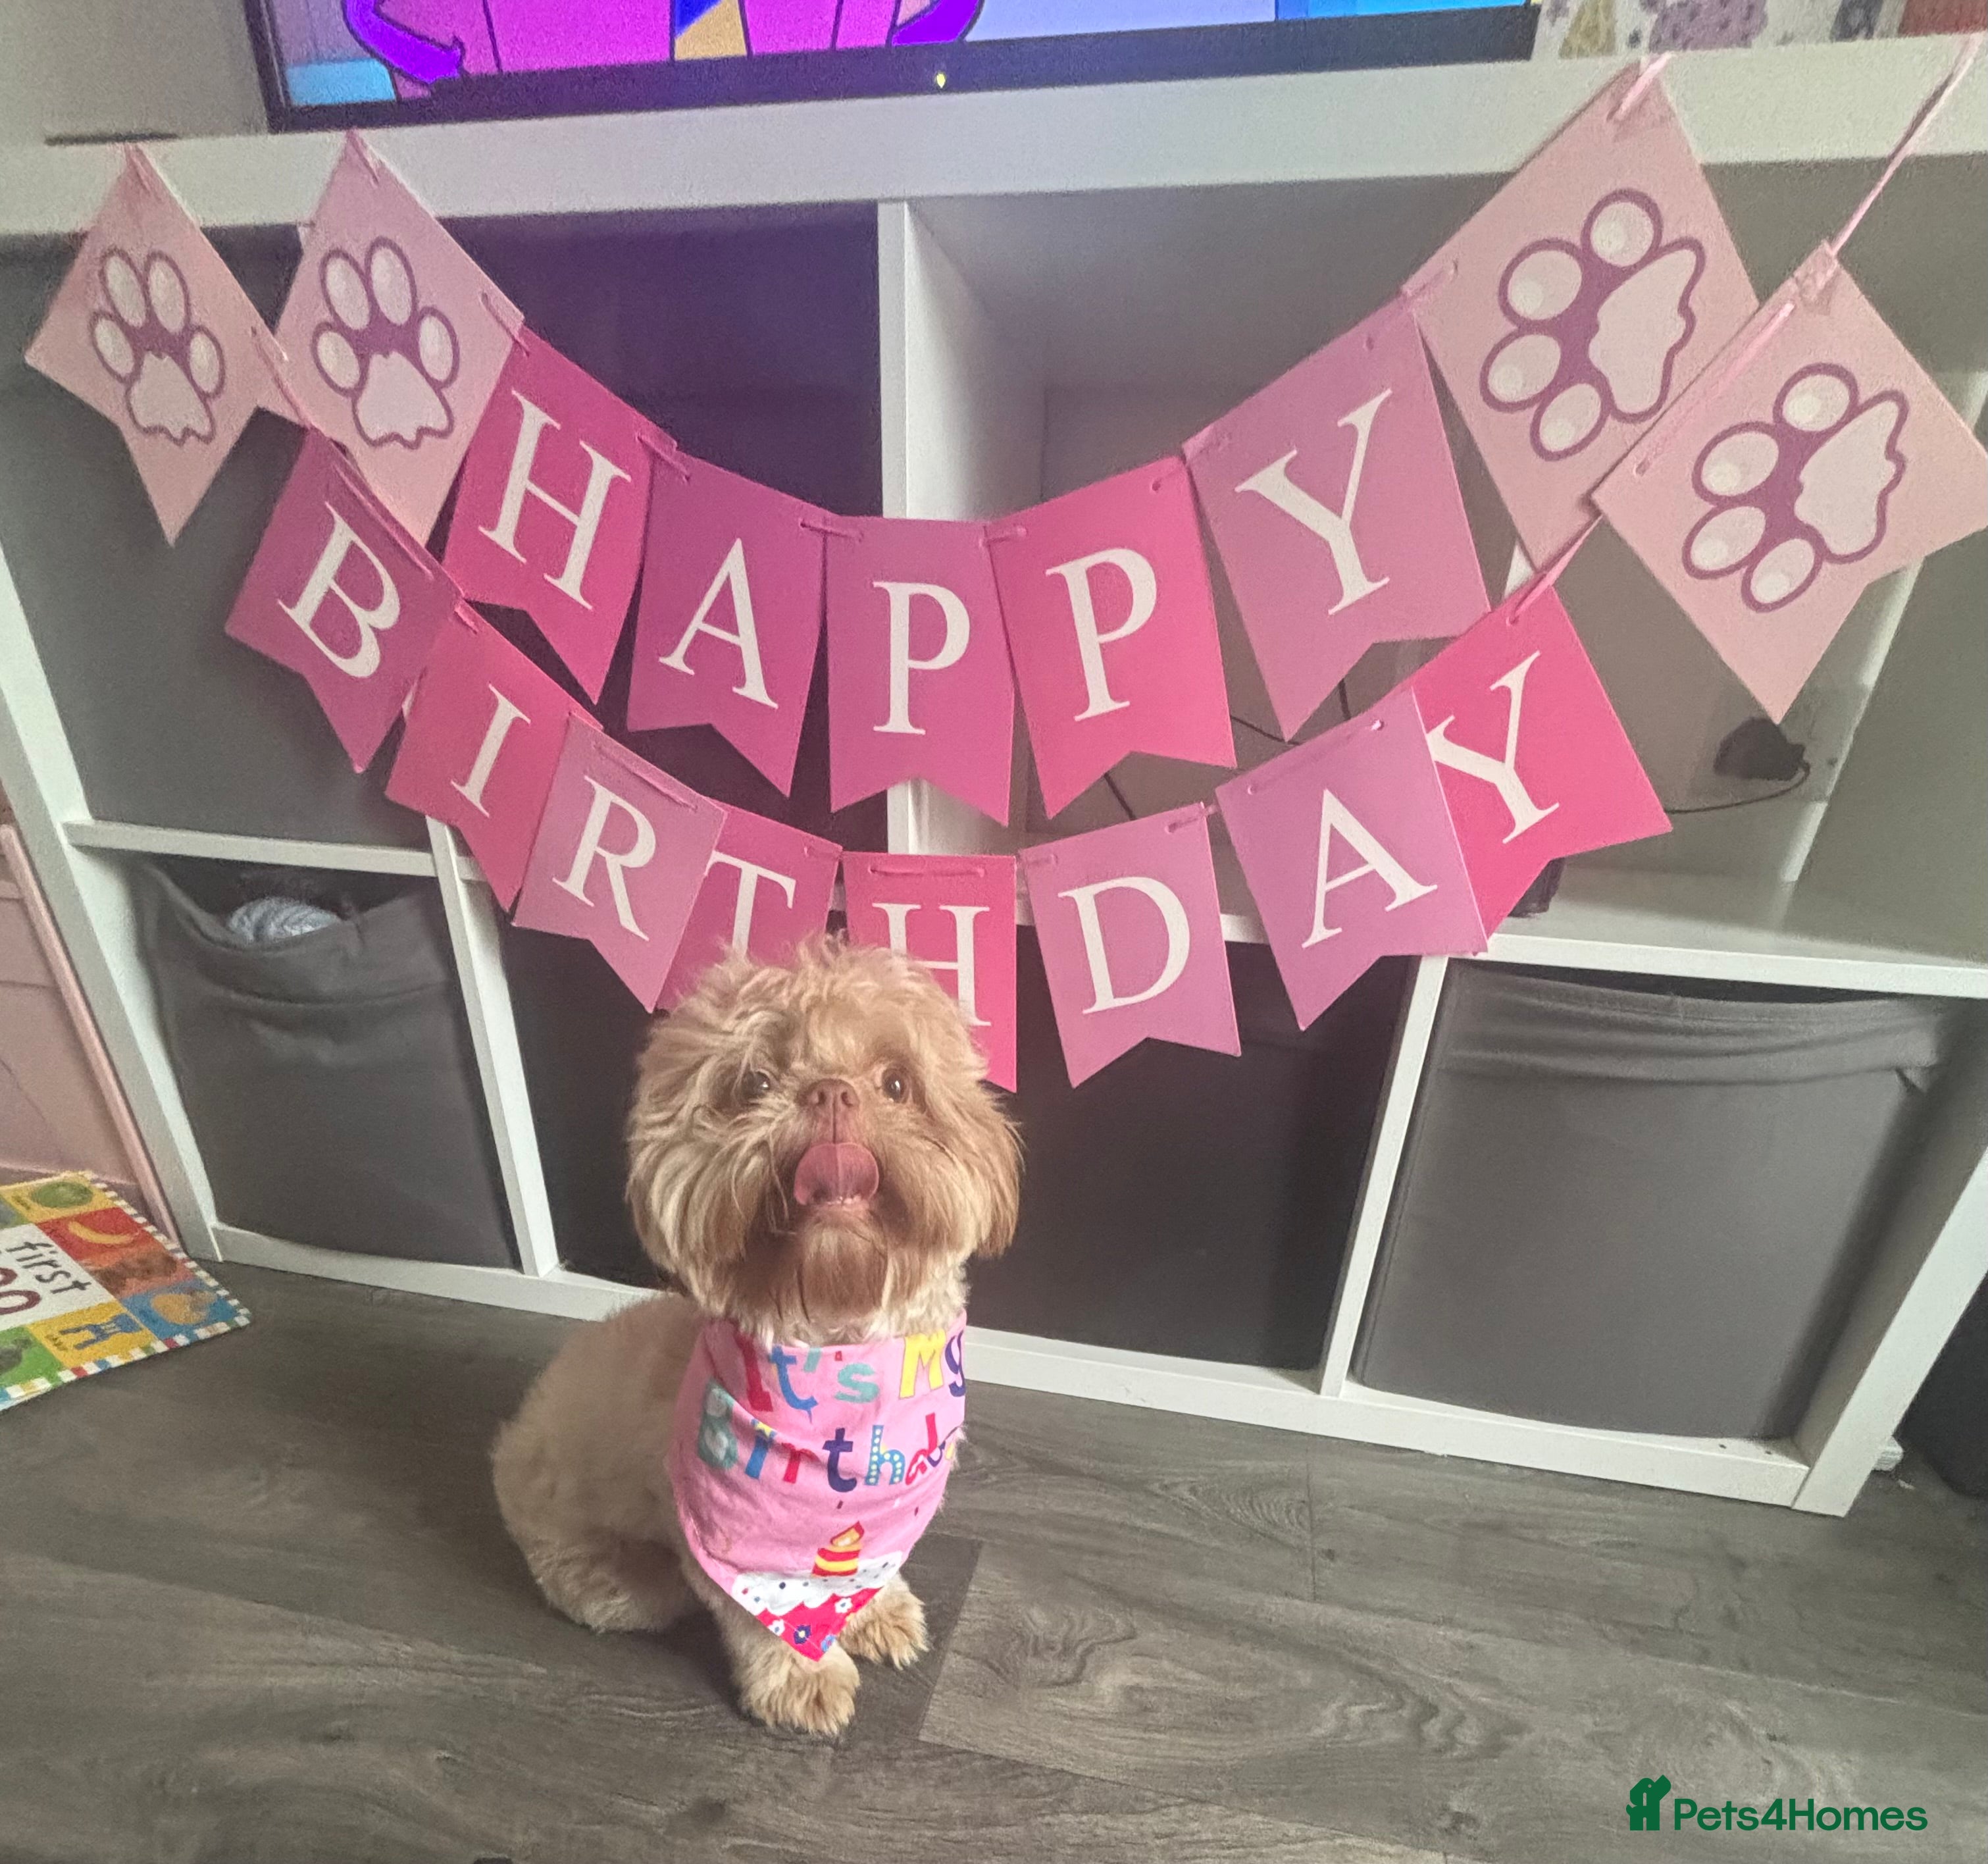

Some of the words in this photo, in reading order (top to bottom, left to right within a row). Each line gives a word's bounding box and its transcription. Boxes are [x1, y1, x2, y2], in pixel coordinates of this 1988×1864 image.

[478, 388, 1392, 736] HAPPY
[277, 501, 1560, 1027] BIRTHDAY
[6, 1241, 92, 1294] first
